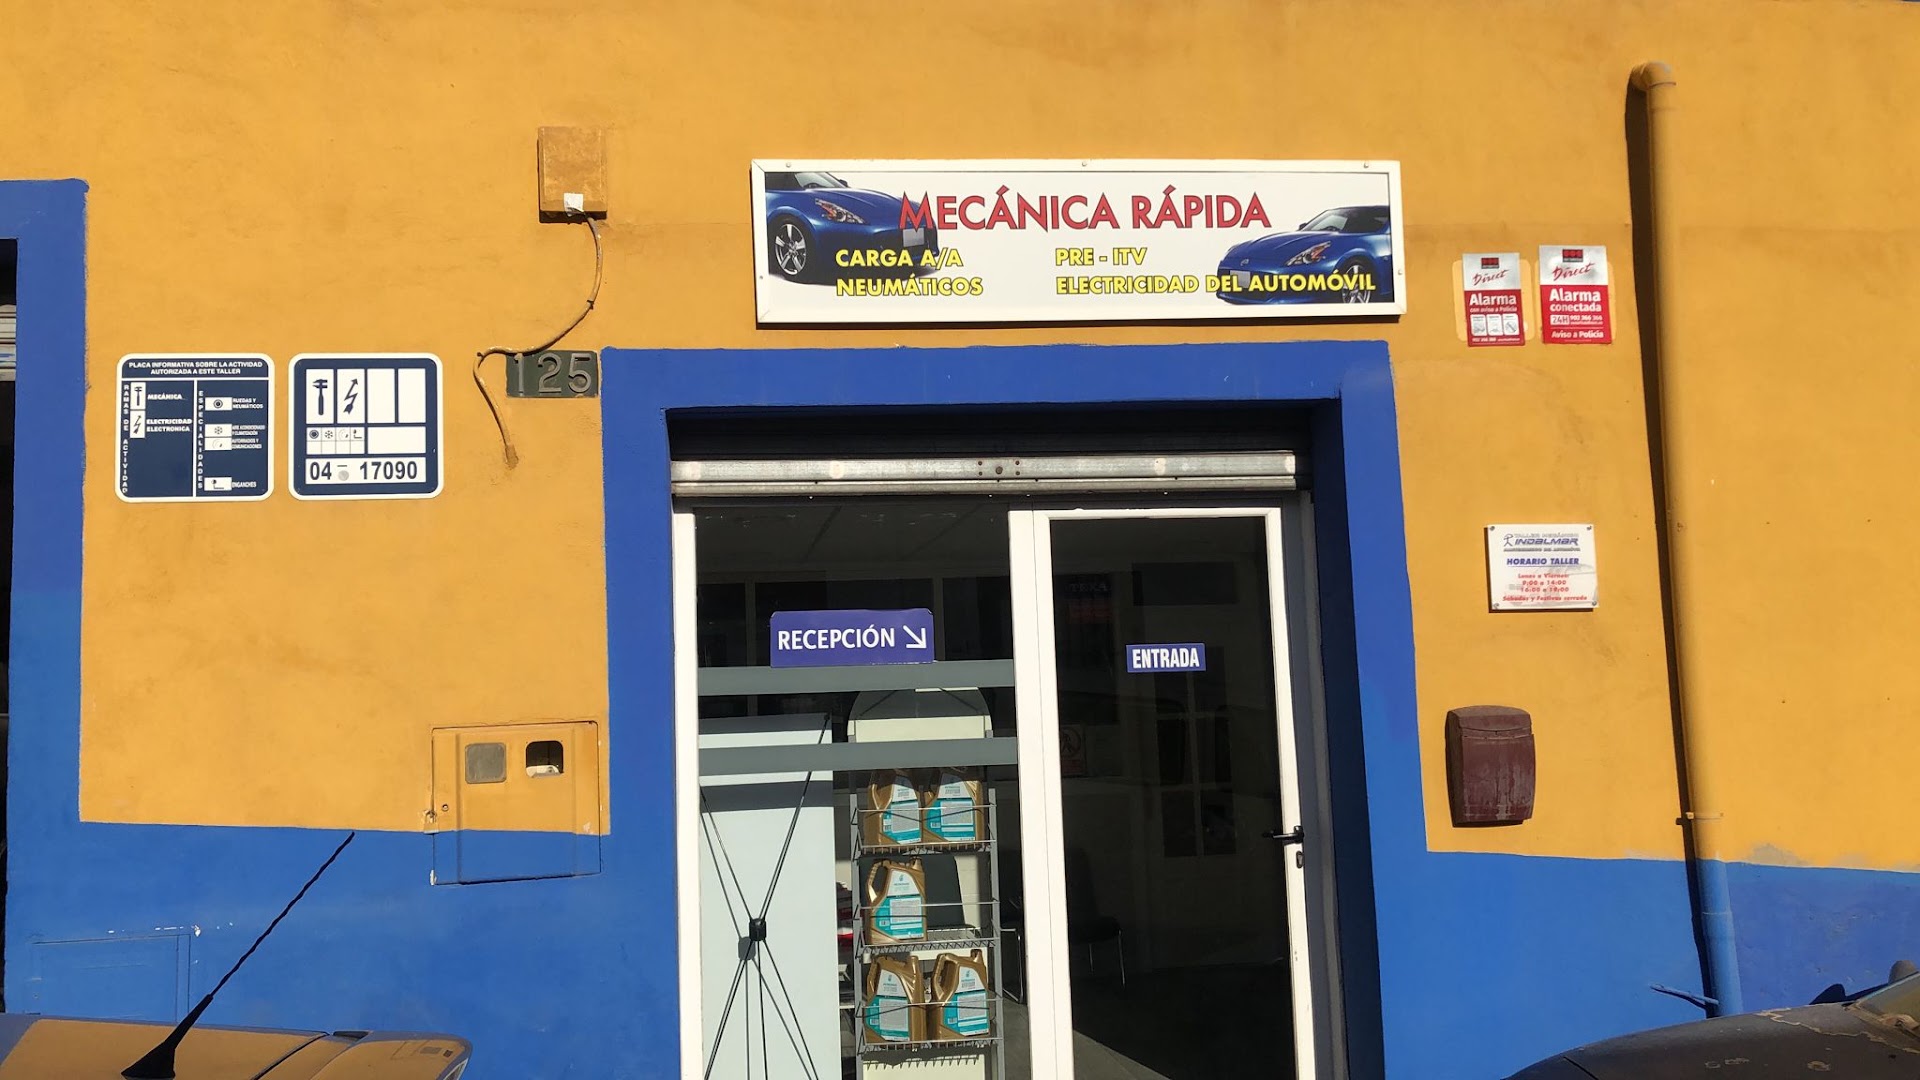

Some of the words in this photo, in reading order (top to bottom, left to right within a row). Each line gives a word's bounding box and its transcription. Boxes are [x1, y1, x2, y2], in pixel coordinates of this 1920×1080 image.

[899, 185, 1120, 232] MECÁNICA
[1132, 185, 1272, 229] RÁPIDA
[835, 249, 913, 268] CARGA
[920, 248, 964, 270] A/A
[1055, 247, 1095, 266] PRE
[1113, 247, 1148, 266] ITV
[836, 274, 983, 296] NEUMÁTICOS
[1056, 275, 1200, 295] ELECTRICIDAD
[1206, 274, 1242, 293] DEL
[1248, 270, 1376, 292] AUTOMÓVIL
[1470, 293, 1516, 306] Alarma
[1550, 288, 1600, 302] Alarma
[1550, 302, 1602, 312] conectada
[1552, 316, 1568, 324] 24H
[1551, 330, 1572, 338] Aviso
[514, 353, 592, 393] 125
[123, 420, 129, 431] DE
[310, 462, 332, 480] 04
[360, 460, 418, 480] 17090
[778, 624, 895, 650] RECEPCIÓN
[1132, 648, 1200, 669] ENTRADA
